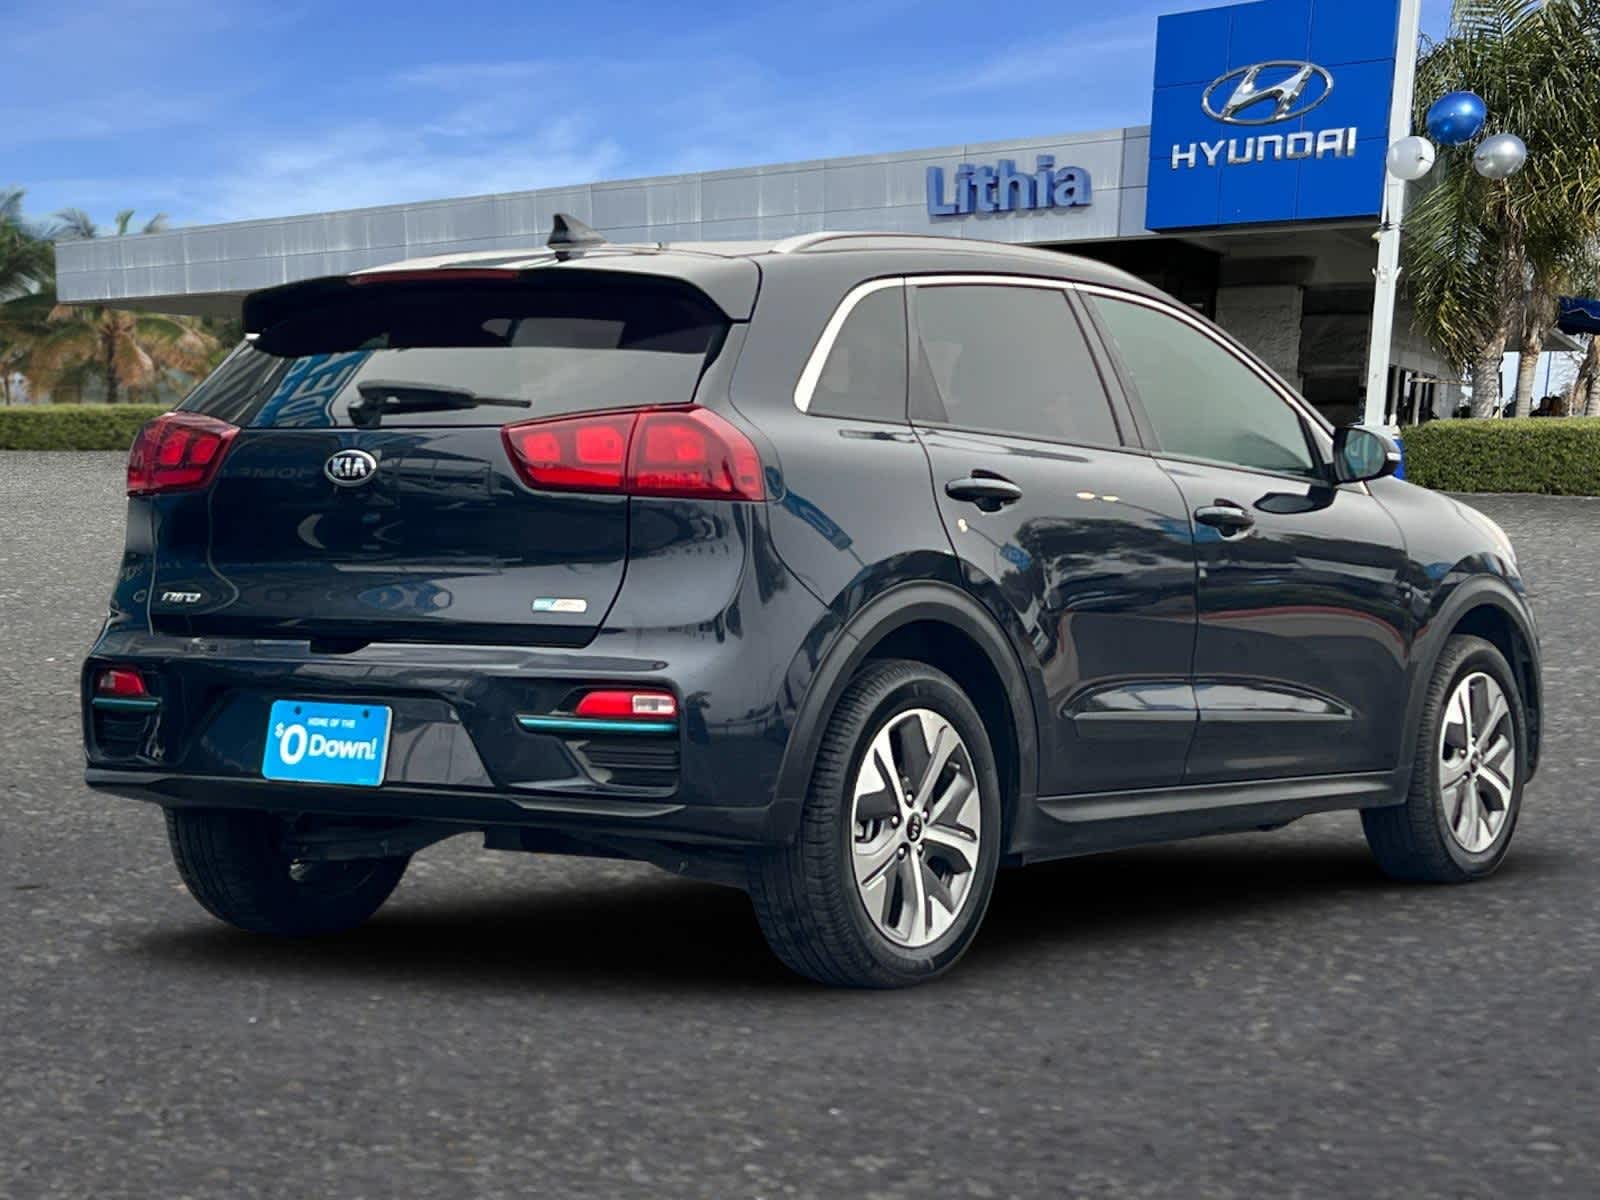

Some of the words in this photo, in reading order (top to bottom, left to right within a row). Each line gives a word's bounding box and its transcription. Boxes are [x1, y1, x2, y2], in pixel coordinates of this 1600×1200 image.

[1171, 126, 1358, 170] HYUNDAI
[926, 154, 1092, 218] Lithia
[331, 456, 368, 477] KIA
[307, 717, 328, 728] HOME
[329, 718, 340, 729] OF
[341, 719, 356, 729] THE
[308, 733, 378, 760] Down!
